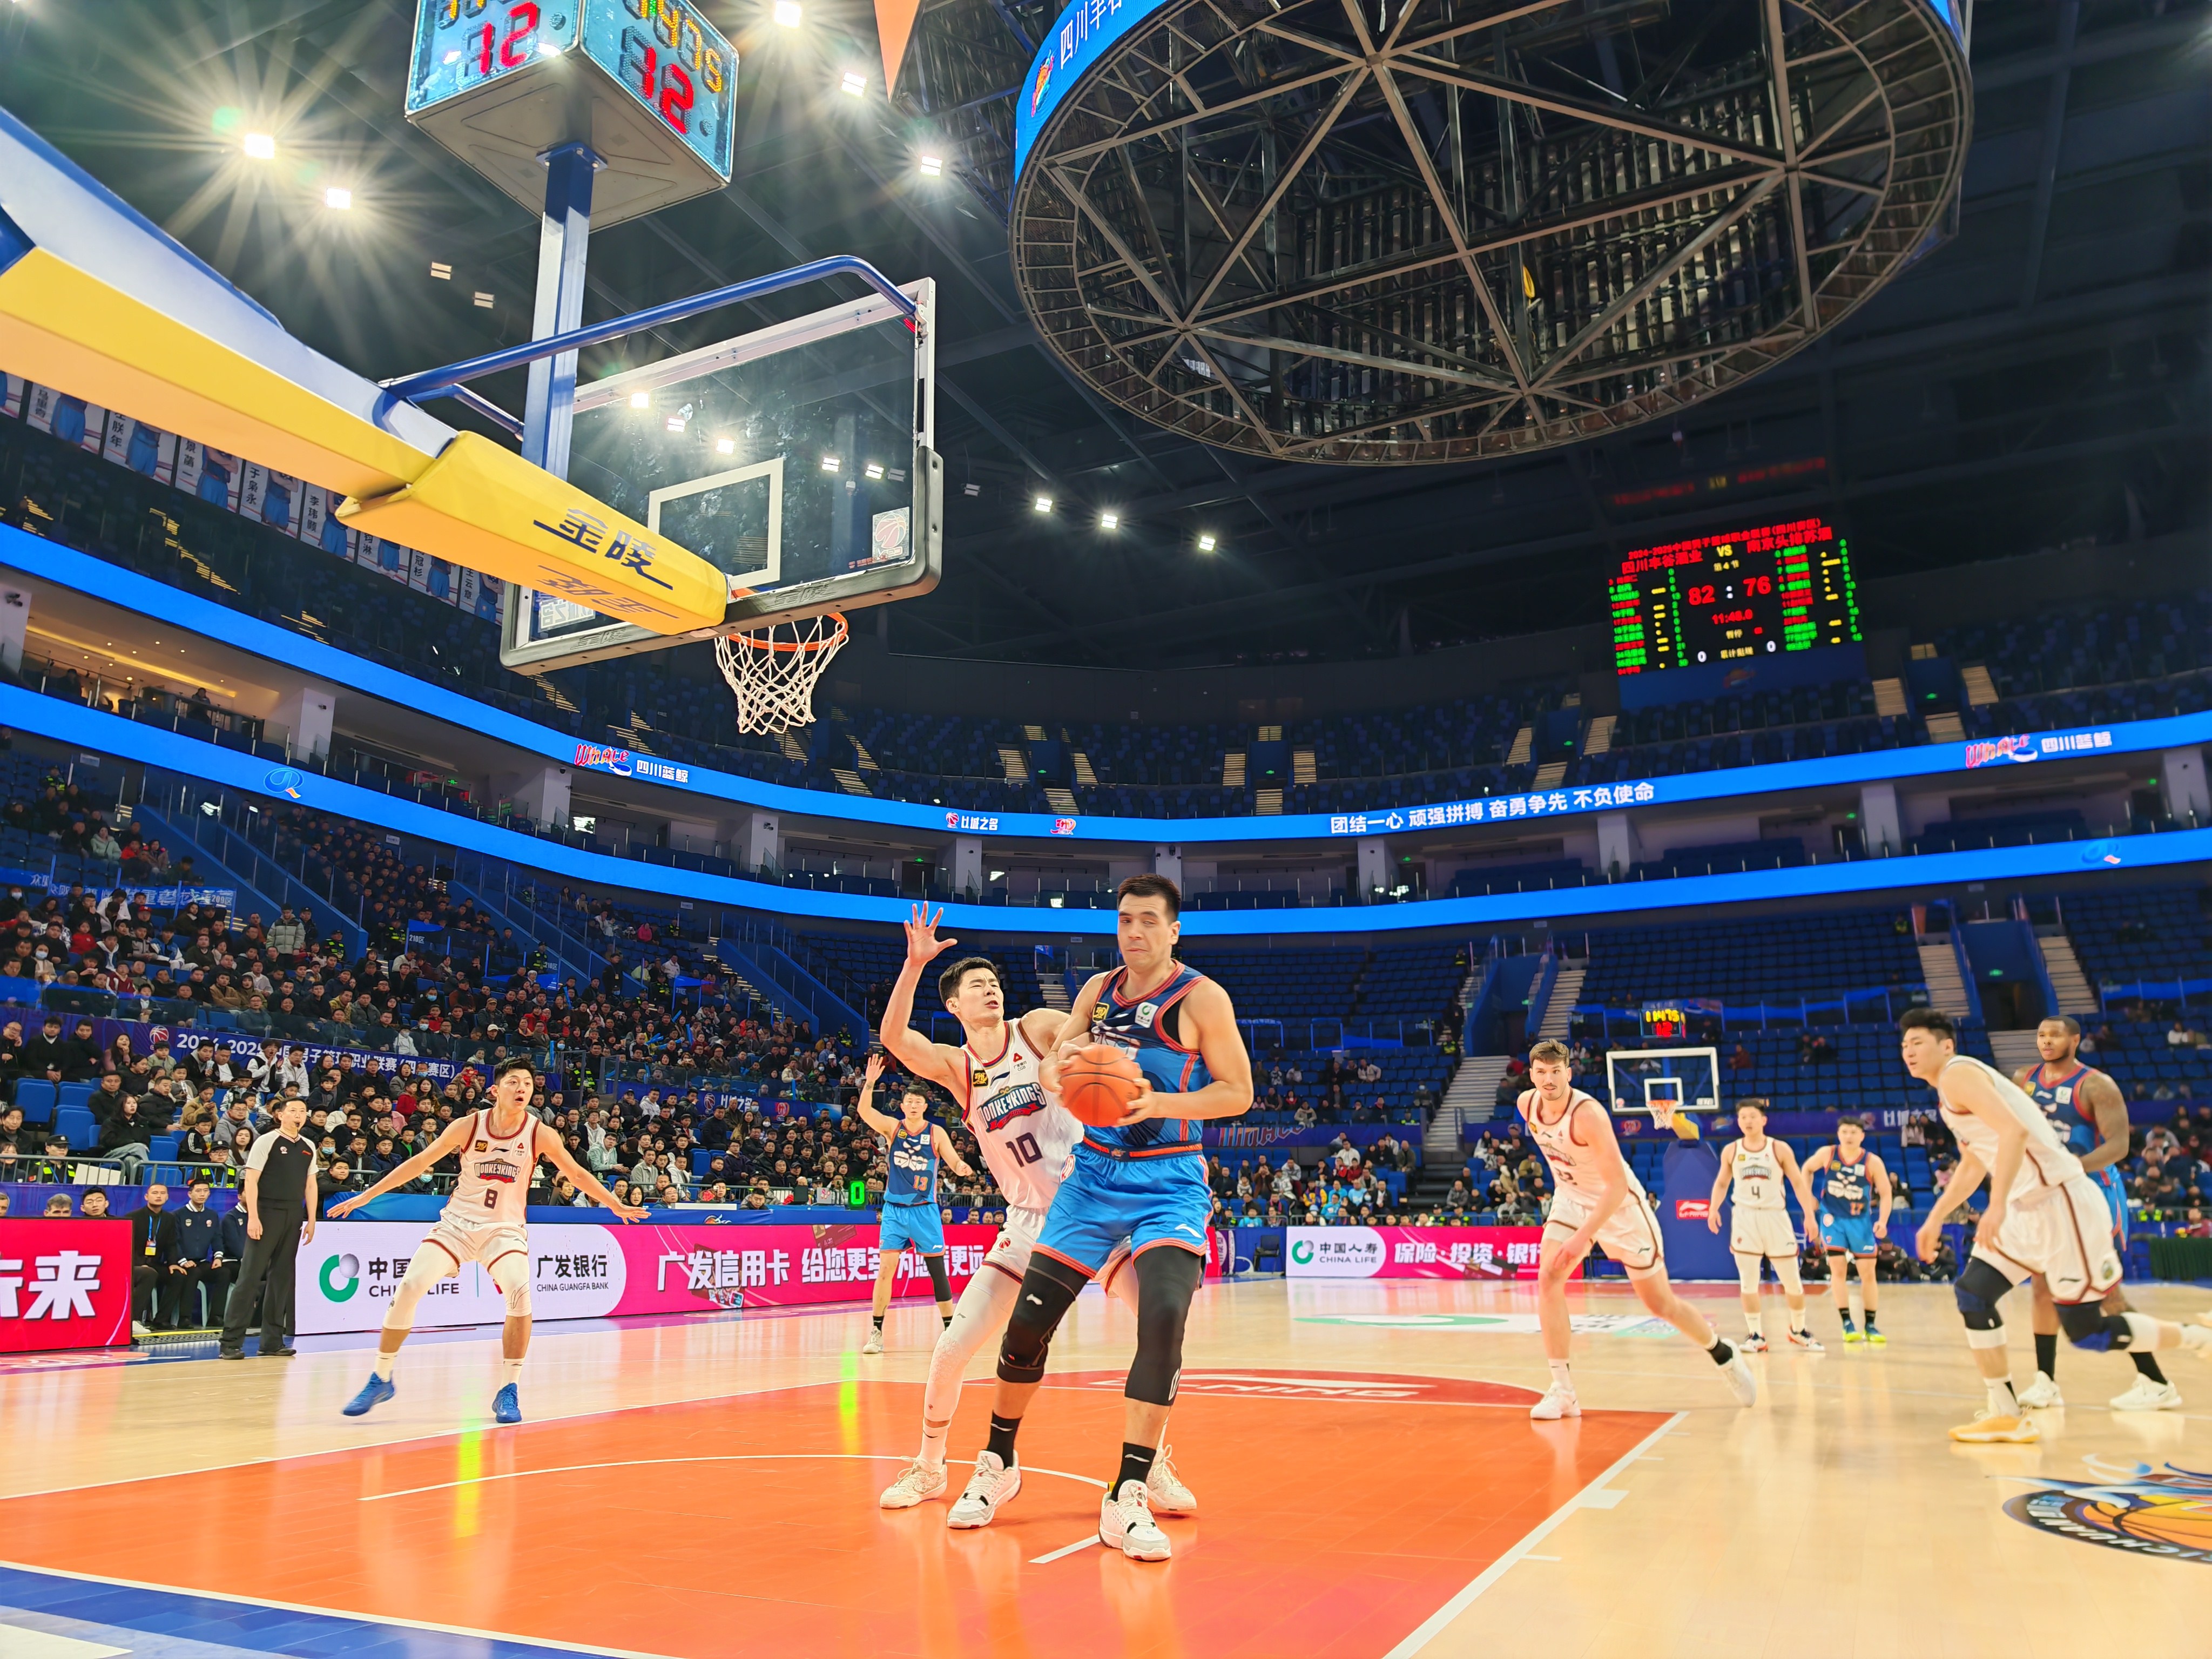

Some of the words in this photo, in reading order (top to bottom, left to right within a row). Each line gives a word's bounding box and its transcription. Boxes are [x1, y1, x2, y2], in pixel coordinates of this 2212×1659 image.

[478, 1, 535, 75] 12
[644, 47, 694, 134] 12
[533, 508, 673, 591] 金陵
[1716, 544, 1732, 557] VS
[1622, 550, 1703, 575] 四川丰谷酒业
[1688, 585, 1716, 605] 82
[1743, 576, 1771, 597] 76
[1766, 640, 1776, 652] 0
[1698, 651, 1707, 662] 0
[2041, 731, 2112, 753] 四川蓝鲸
[637, 760, 689, 783] 四川蓝鲸
[1331, 813, 1403, 834] 团结一心
[1409, 802, 1484, 828] 顽强拼搏
[1488, 792, 1568, 819] 奋勇争先
[1573, 781, 1655, 808] 不负使命
[961, 816, 999, 831] 以城之名
[409, 934, 425, 944] 210区
[1656, 1022, 1673, 1037] 12
[1006, 1132, 1044, 1168] 10
[851, 1181, 865, 1205] 0
[913, 1175, 928, 1191] 13
[1752, 1186, 1761, 1199] 4
[484, 1188, 498, 1210] 8
[1319, 1242, 1378, 1255] 中国人寿
[537, 1254, 608, 1278] 广发银行
[657, 1250, 790, 1291] 广发信用卡
[802, 1247, 880, 1284] 给您更多
[427, 1283, 460, 1295] LIFE
[537, 1284, 558, 1292] CHINA
[559, 1282, 590, 1291] GUANGFA
[592, 1282, 609, 1290] BANK
[1088, 1379, 1419, 1398] L-NING
